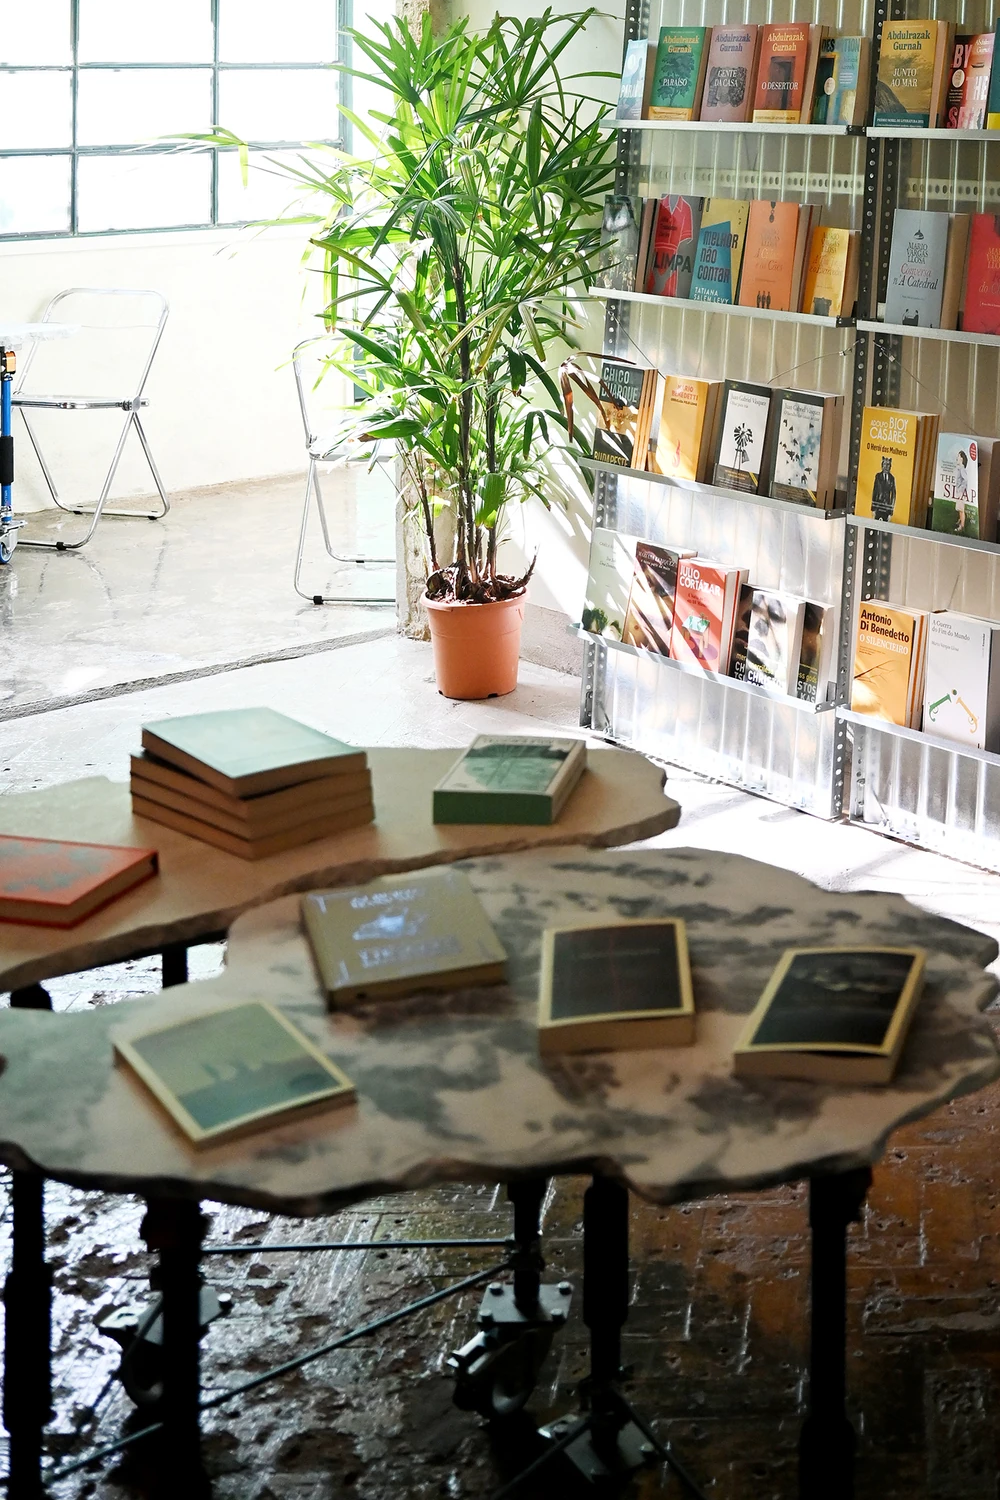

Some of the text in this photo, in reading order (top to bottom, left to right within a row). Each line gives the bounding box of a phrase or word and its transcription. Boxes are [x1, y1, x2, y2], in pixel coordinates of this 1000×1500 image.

[767, 32, 804, 42] Abdulrazak
[886, 29, 931, 41] Abdulrazak
[893, 41, 922, 51] Gurnah
[893, 67, 918, 77] JUNTO
[662, 76, 688, 87] PARAÍSO
[891, 79, 918, 88] AO MAR
[654, 250, 692, 274] LIMPA
[901, 263, 932, 278] Conversa
[694, 286, 718, 296] TATIANA
[602, 367, 631, 385] CHICO
[869, 426, 907, 444] CASARES
[940, 473, 956, 484] THE
[943, 483, 976, 504] SLAP
[680, 564, 700, 580] JULIO
[679, 575, 721, 597] CORTÁZAR
[861, 609, 892, 627] Antonio
[860, 620, 910, 644] Di Benedetto
[859, 633, 909, 656] O SILENCIEIRO
